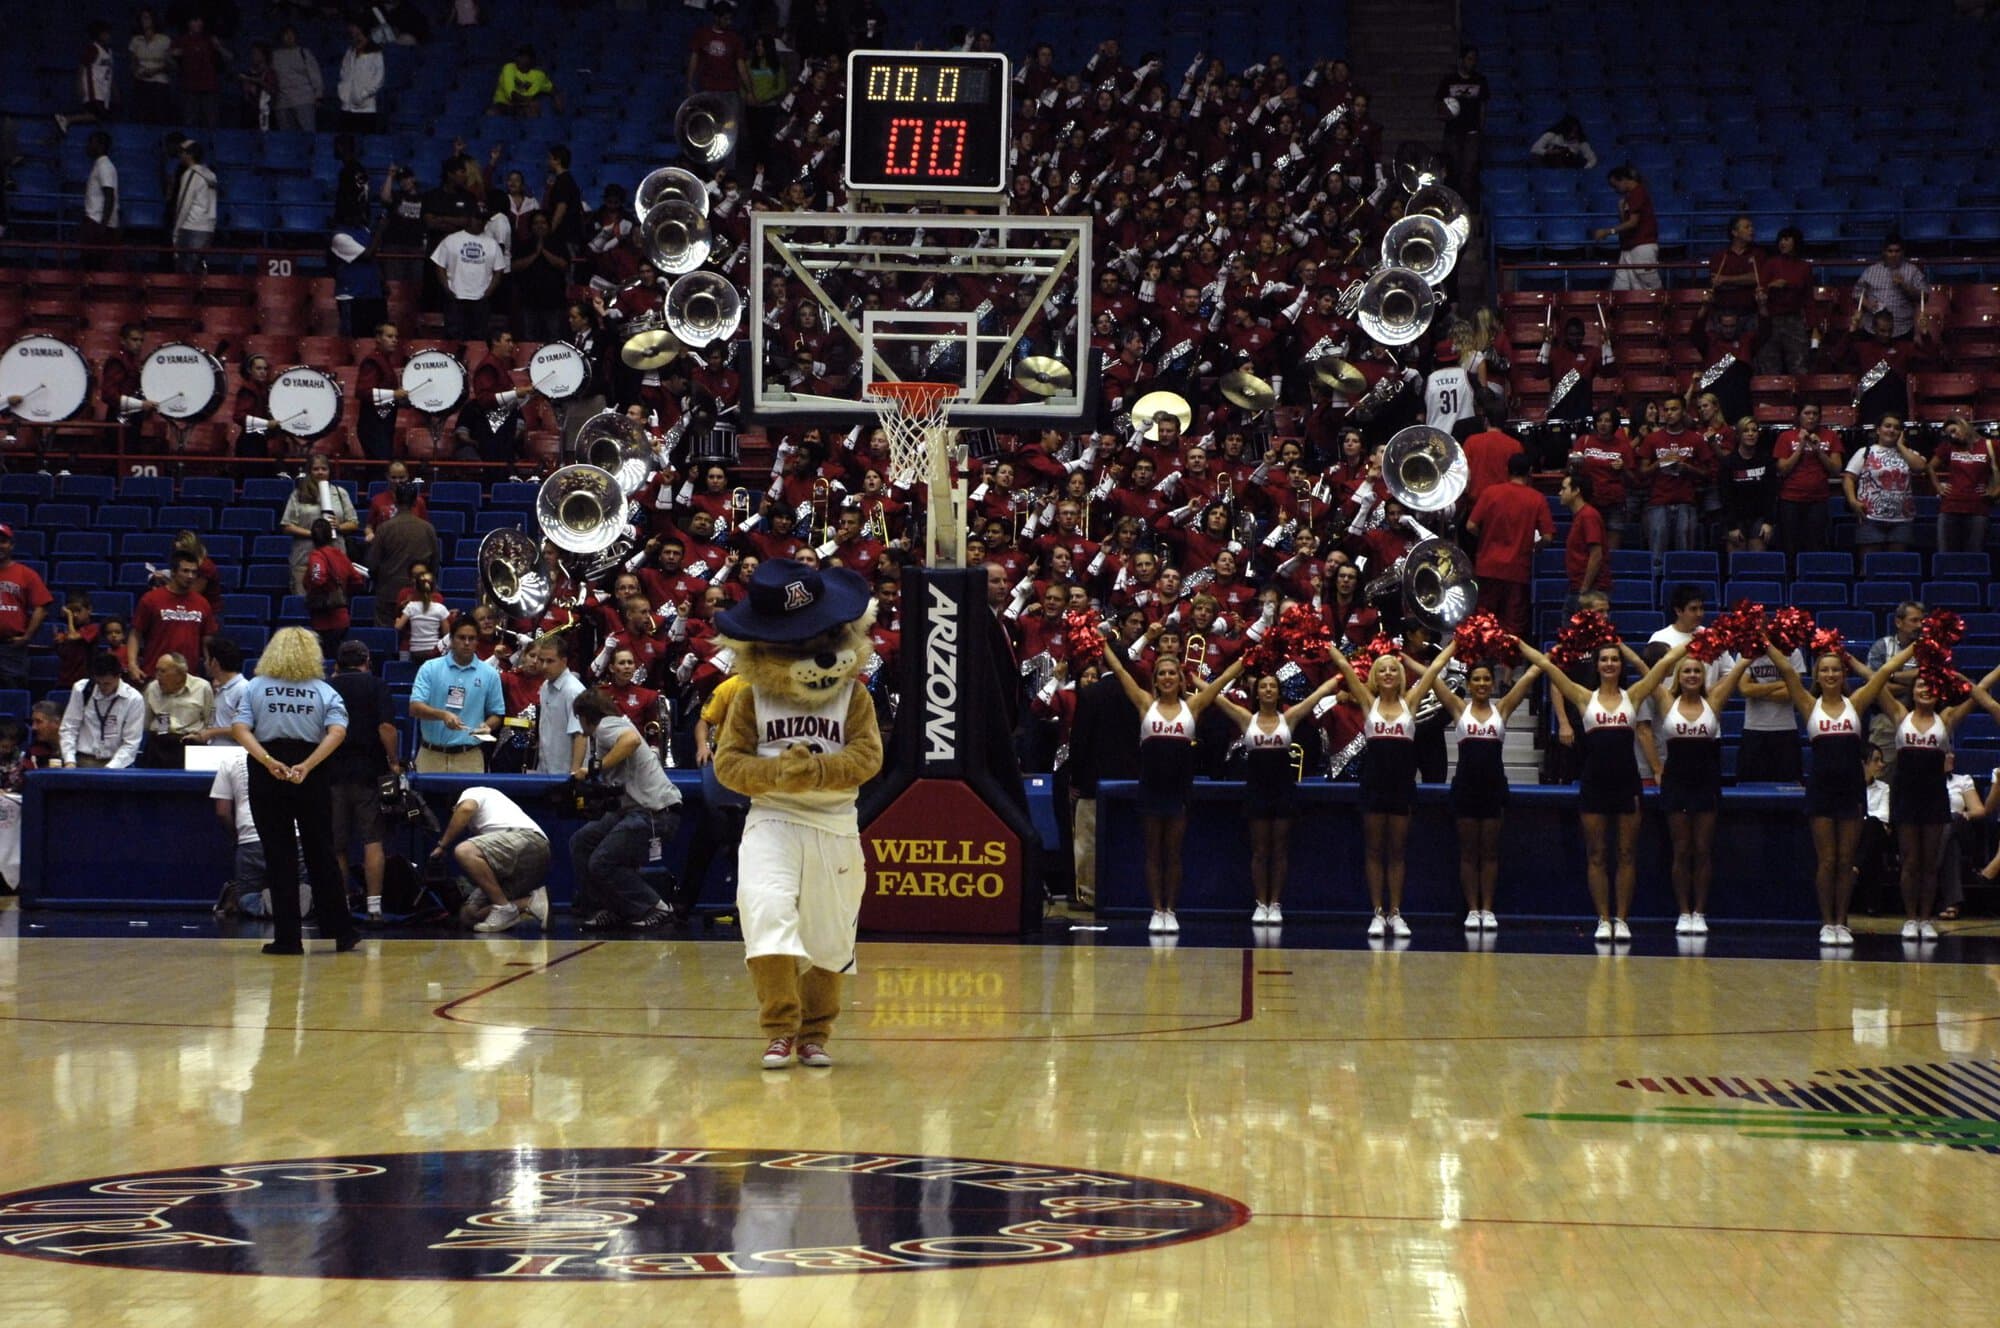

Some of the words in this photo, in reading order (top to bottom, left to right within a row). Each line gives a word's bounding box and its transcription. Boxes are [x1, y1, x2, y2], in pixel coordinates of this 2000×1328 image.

[866, 66, 960, 102] 00.0
[885, 118, 967, 176] 00
[268, 259, 292, 277] 20
[30, 347, 64, 358] YAMAHA
[167, 355, 199, 364] YAMAHA
[546, 351, 572, 363] YAMAHA
[422, 361, 448, 370] YAMAHA
[293, 379, 325, 389] YAMAHA
[1439, 388, 1458, 415] 31
[784, 580, 814, 611] A
[925, 582, 958, 761] ARIZONA
[265, 687, 316, 699] EVENT
[268, 703, 314, 715] STAFF
[766, 715, 841, 744] ARIZONA
[871, 839, 1007, 866] WELLS
[875, 871, 1004, 899] FARGO
